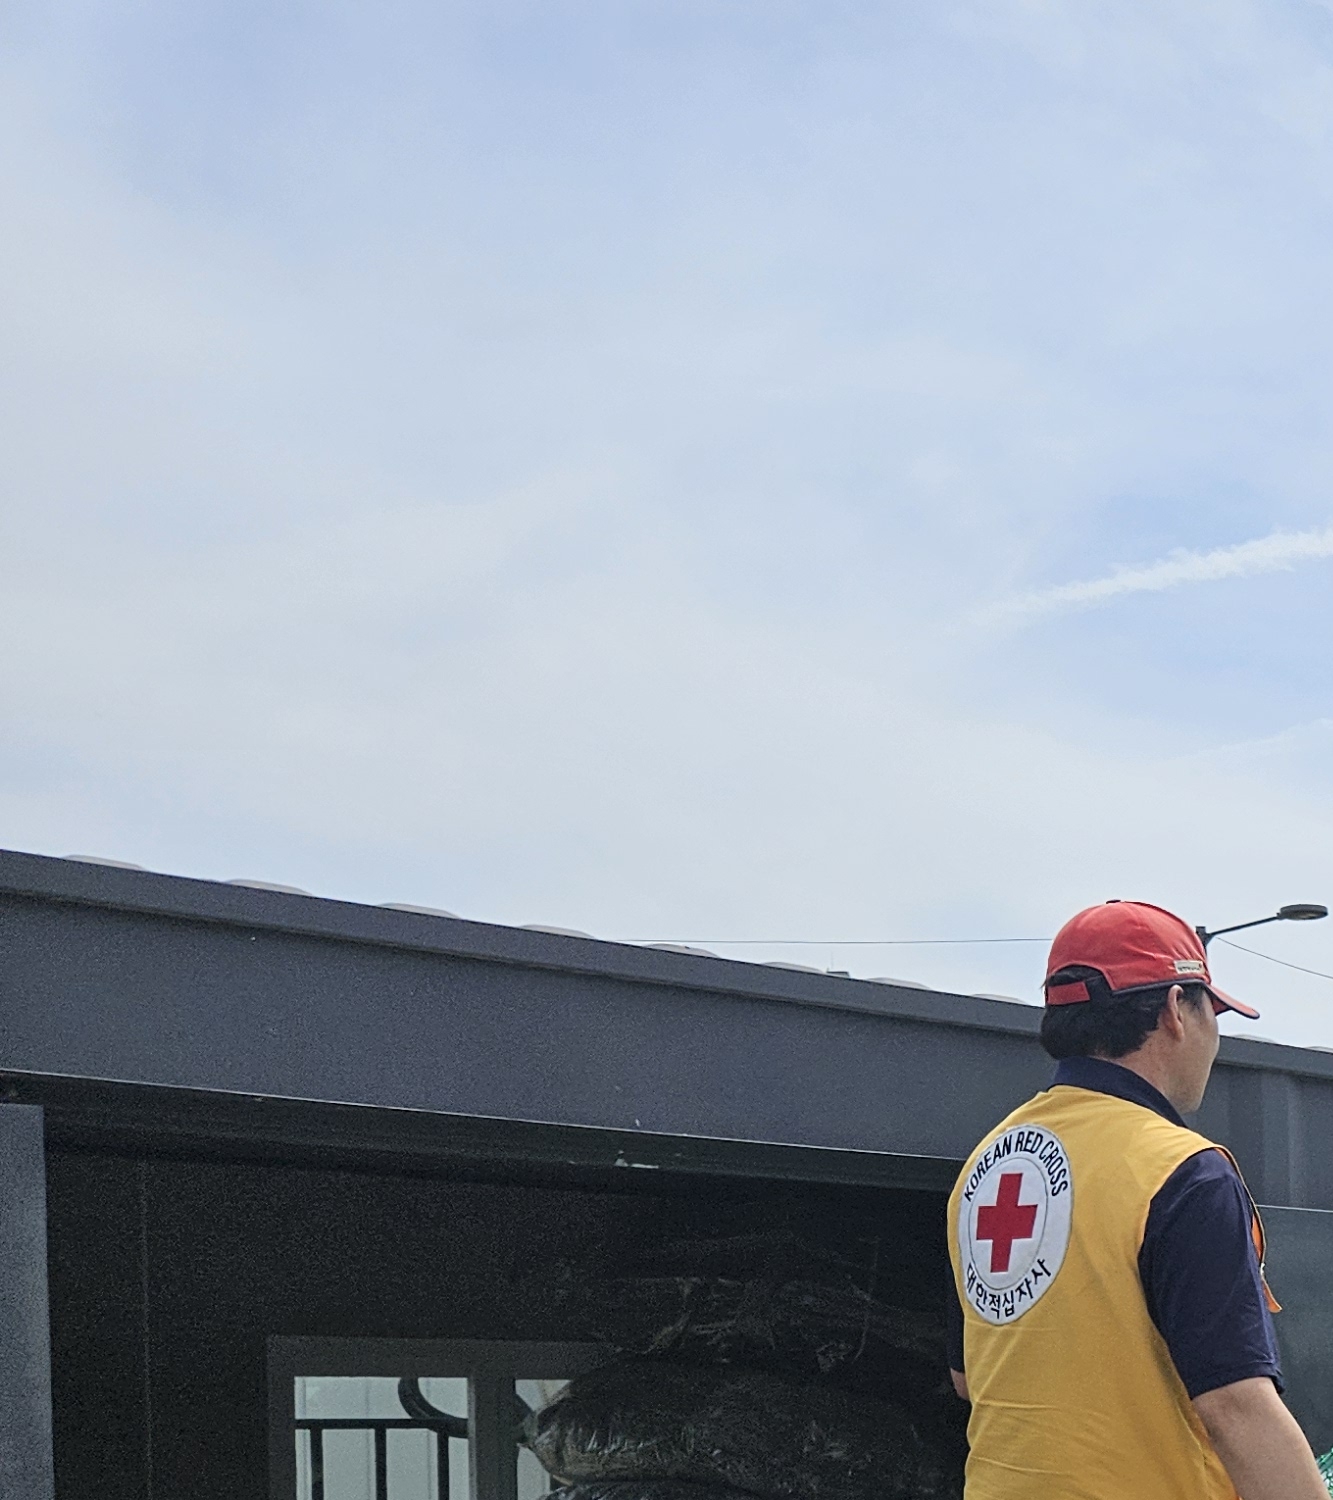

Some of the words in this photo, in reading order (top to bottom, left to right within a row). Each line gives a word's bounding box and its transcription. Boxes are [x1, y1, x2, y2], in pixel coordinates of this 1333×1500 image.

[963, 1134, 1013, 1202] KOREAN
[1015, 1131, 1044, 1154] RED
[1038, 1140, 1069, 1197] CROSS
[966, 1258, 1051, 1319] 대한적십자사
